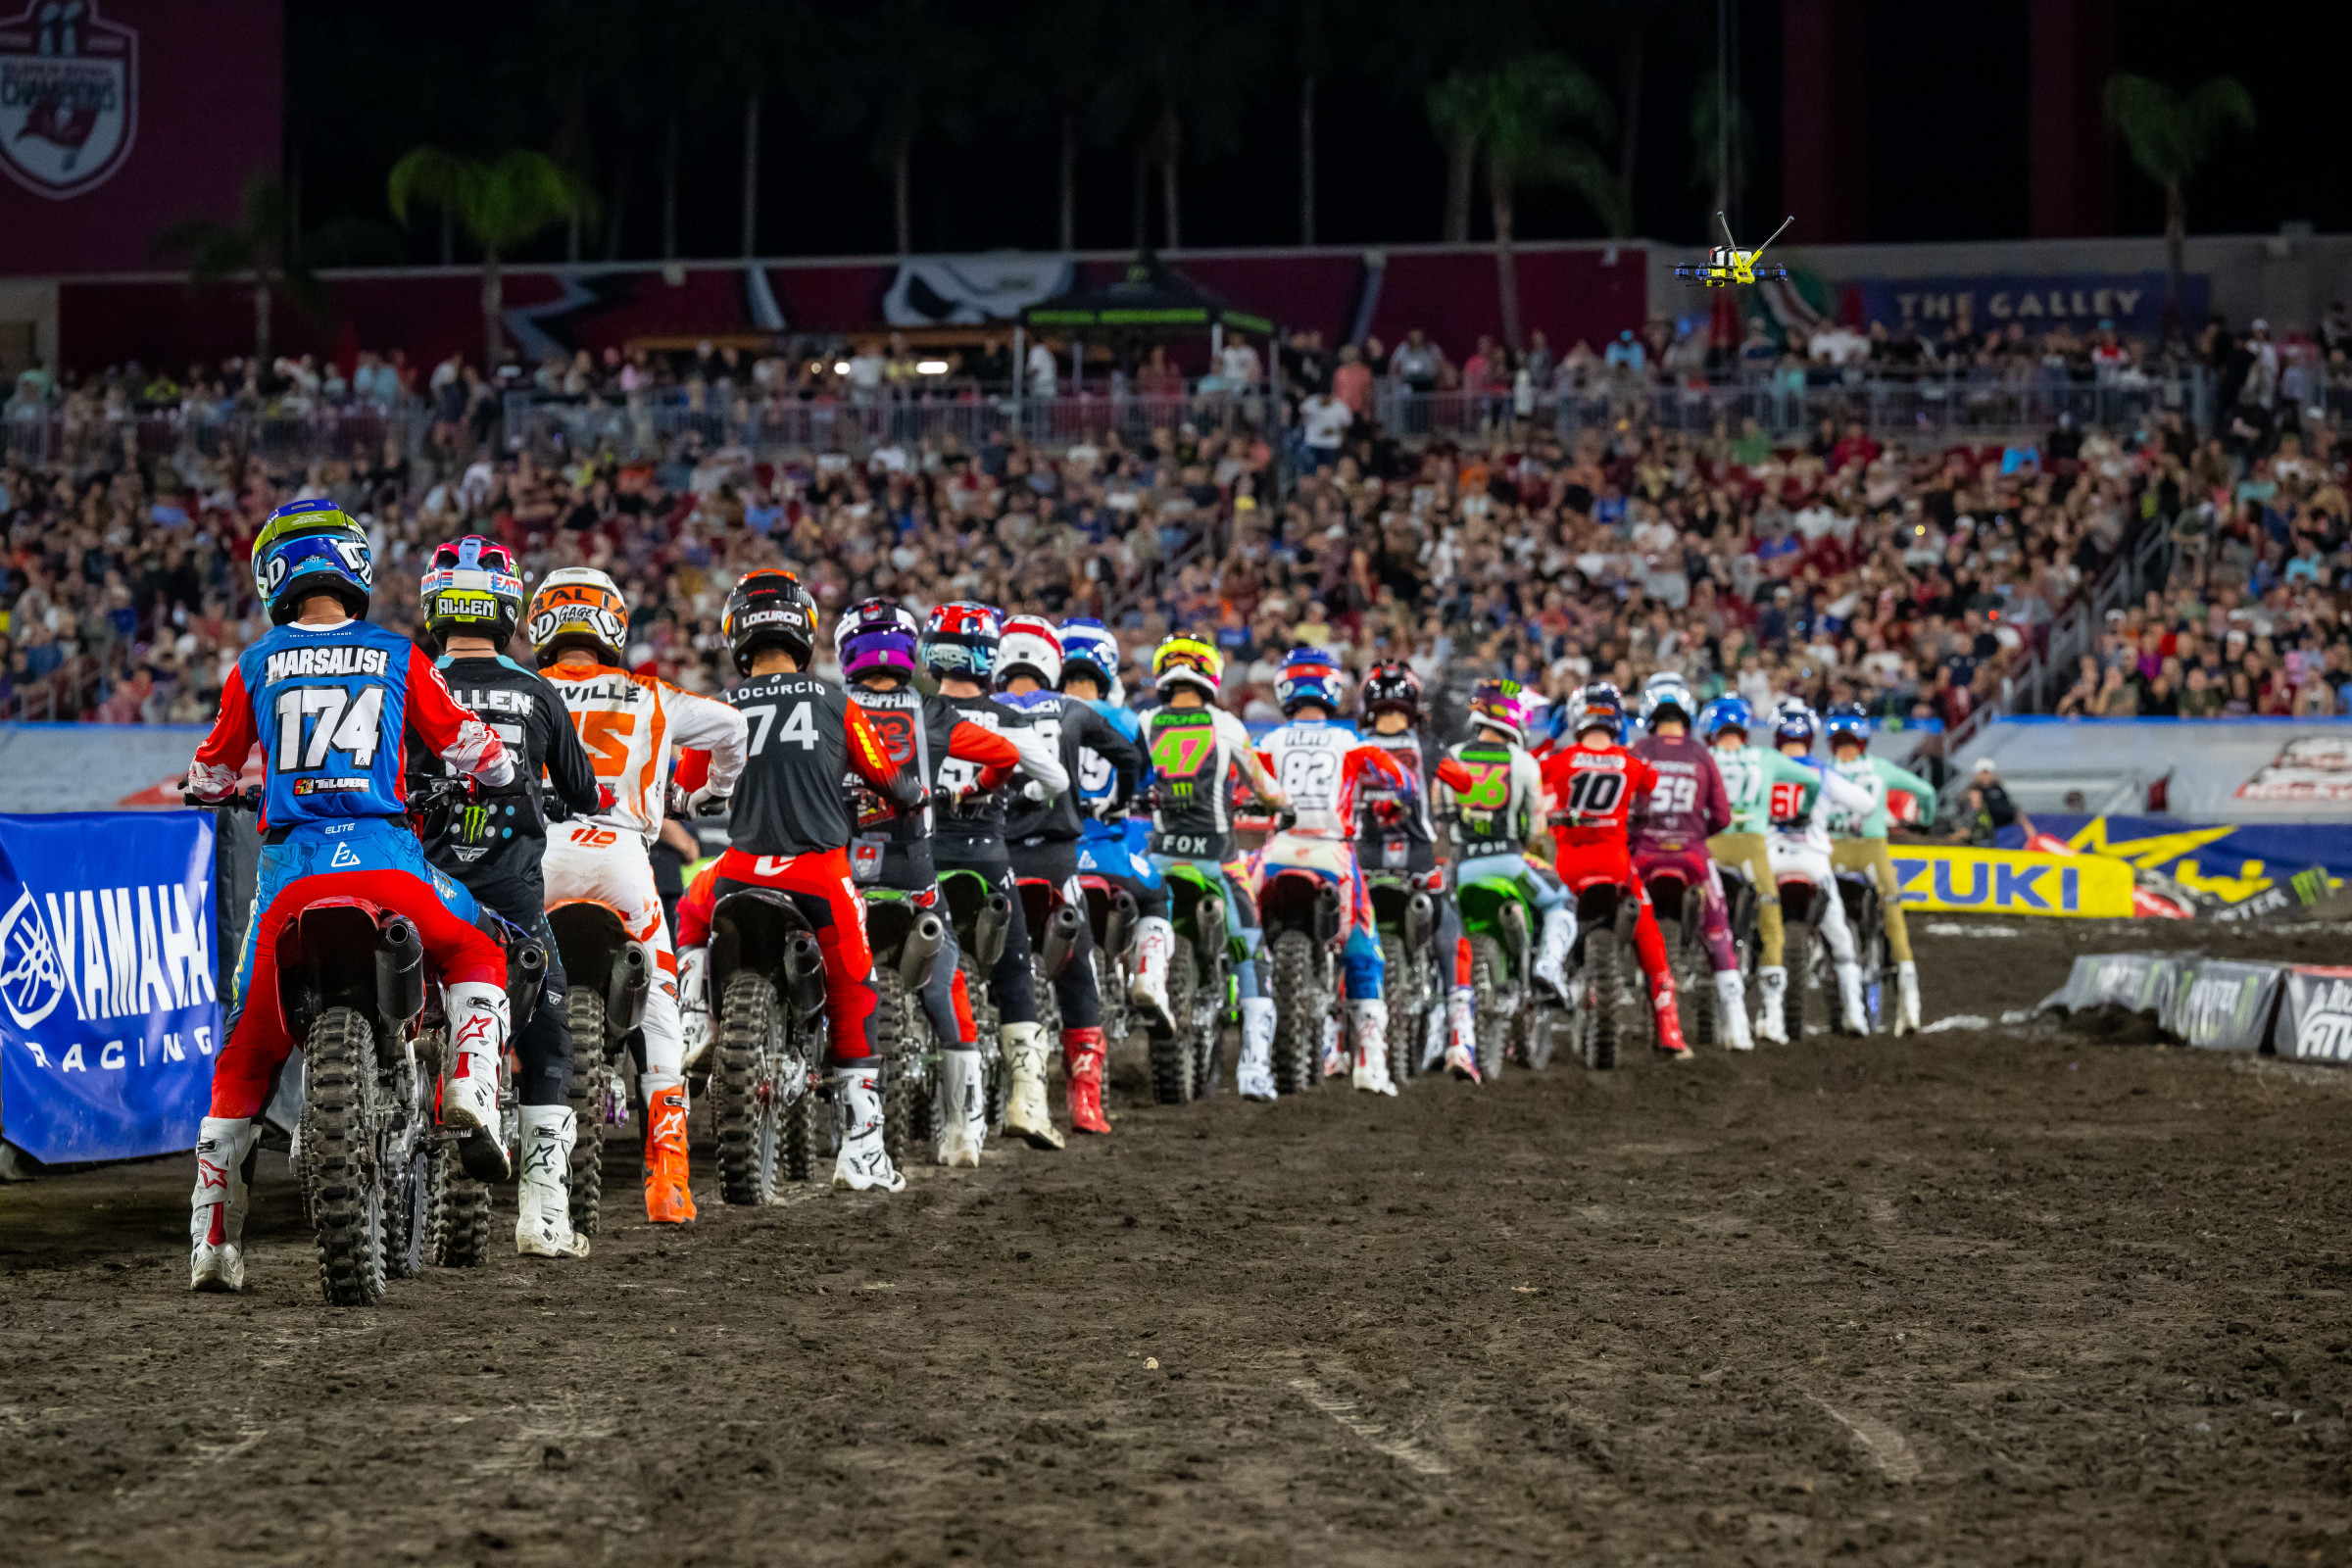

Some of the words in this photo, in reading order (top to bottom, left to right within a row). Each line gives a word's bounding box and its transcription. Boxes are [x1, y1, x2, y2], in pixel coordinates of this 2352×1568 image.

[1896, 291, 1975, 319] THE
[1987, 288, 2142, 318] GALLEY
[437, 598, 496, 618] ALLEN
[741, 610, 804, 629] LOCURCIO
[267, 647, 389, 683] MARSALISI
[452, 689, 533, 716] LLEN
[726, 680, 826, 705] LOCURCIO
[277, 687, 384, 773] 174
[740, 701, 820, 758] 74
[1151, 727, 1216, 777] 47
[1280, 749, 1338, 797] 82
[1569, 770, 1627, 814] 10
[1649, 775, 1697, 812] 59
[324, 822, 356, 835] ELITE
[1162, 834, 1208, 855] FOX
[45, 880, 217, 1021] YAMAHA
[24, 1025, 214, 1073] RACING
